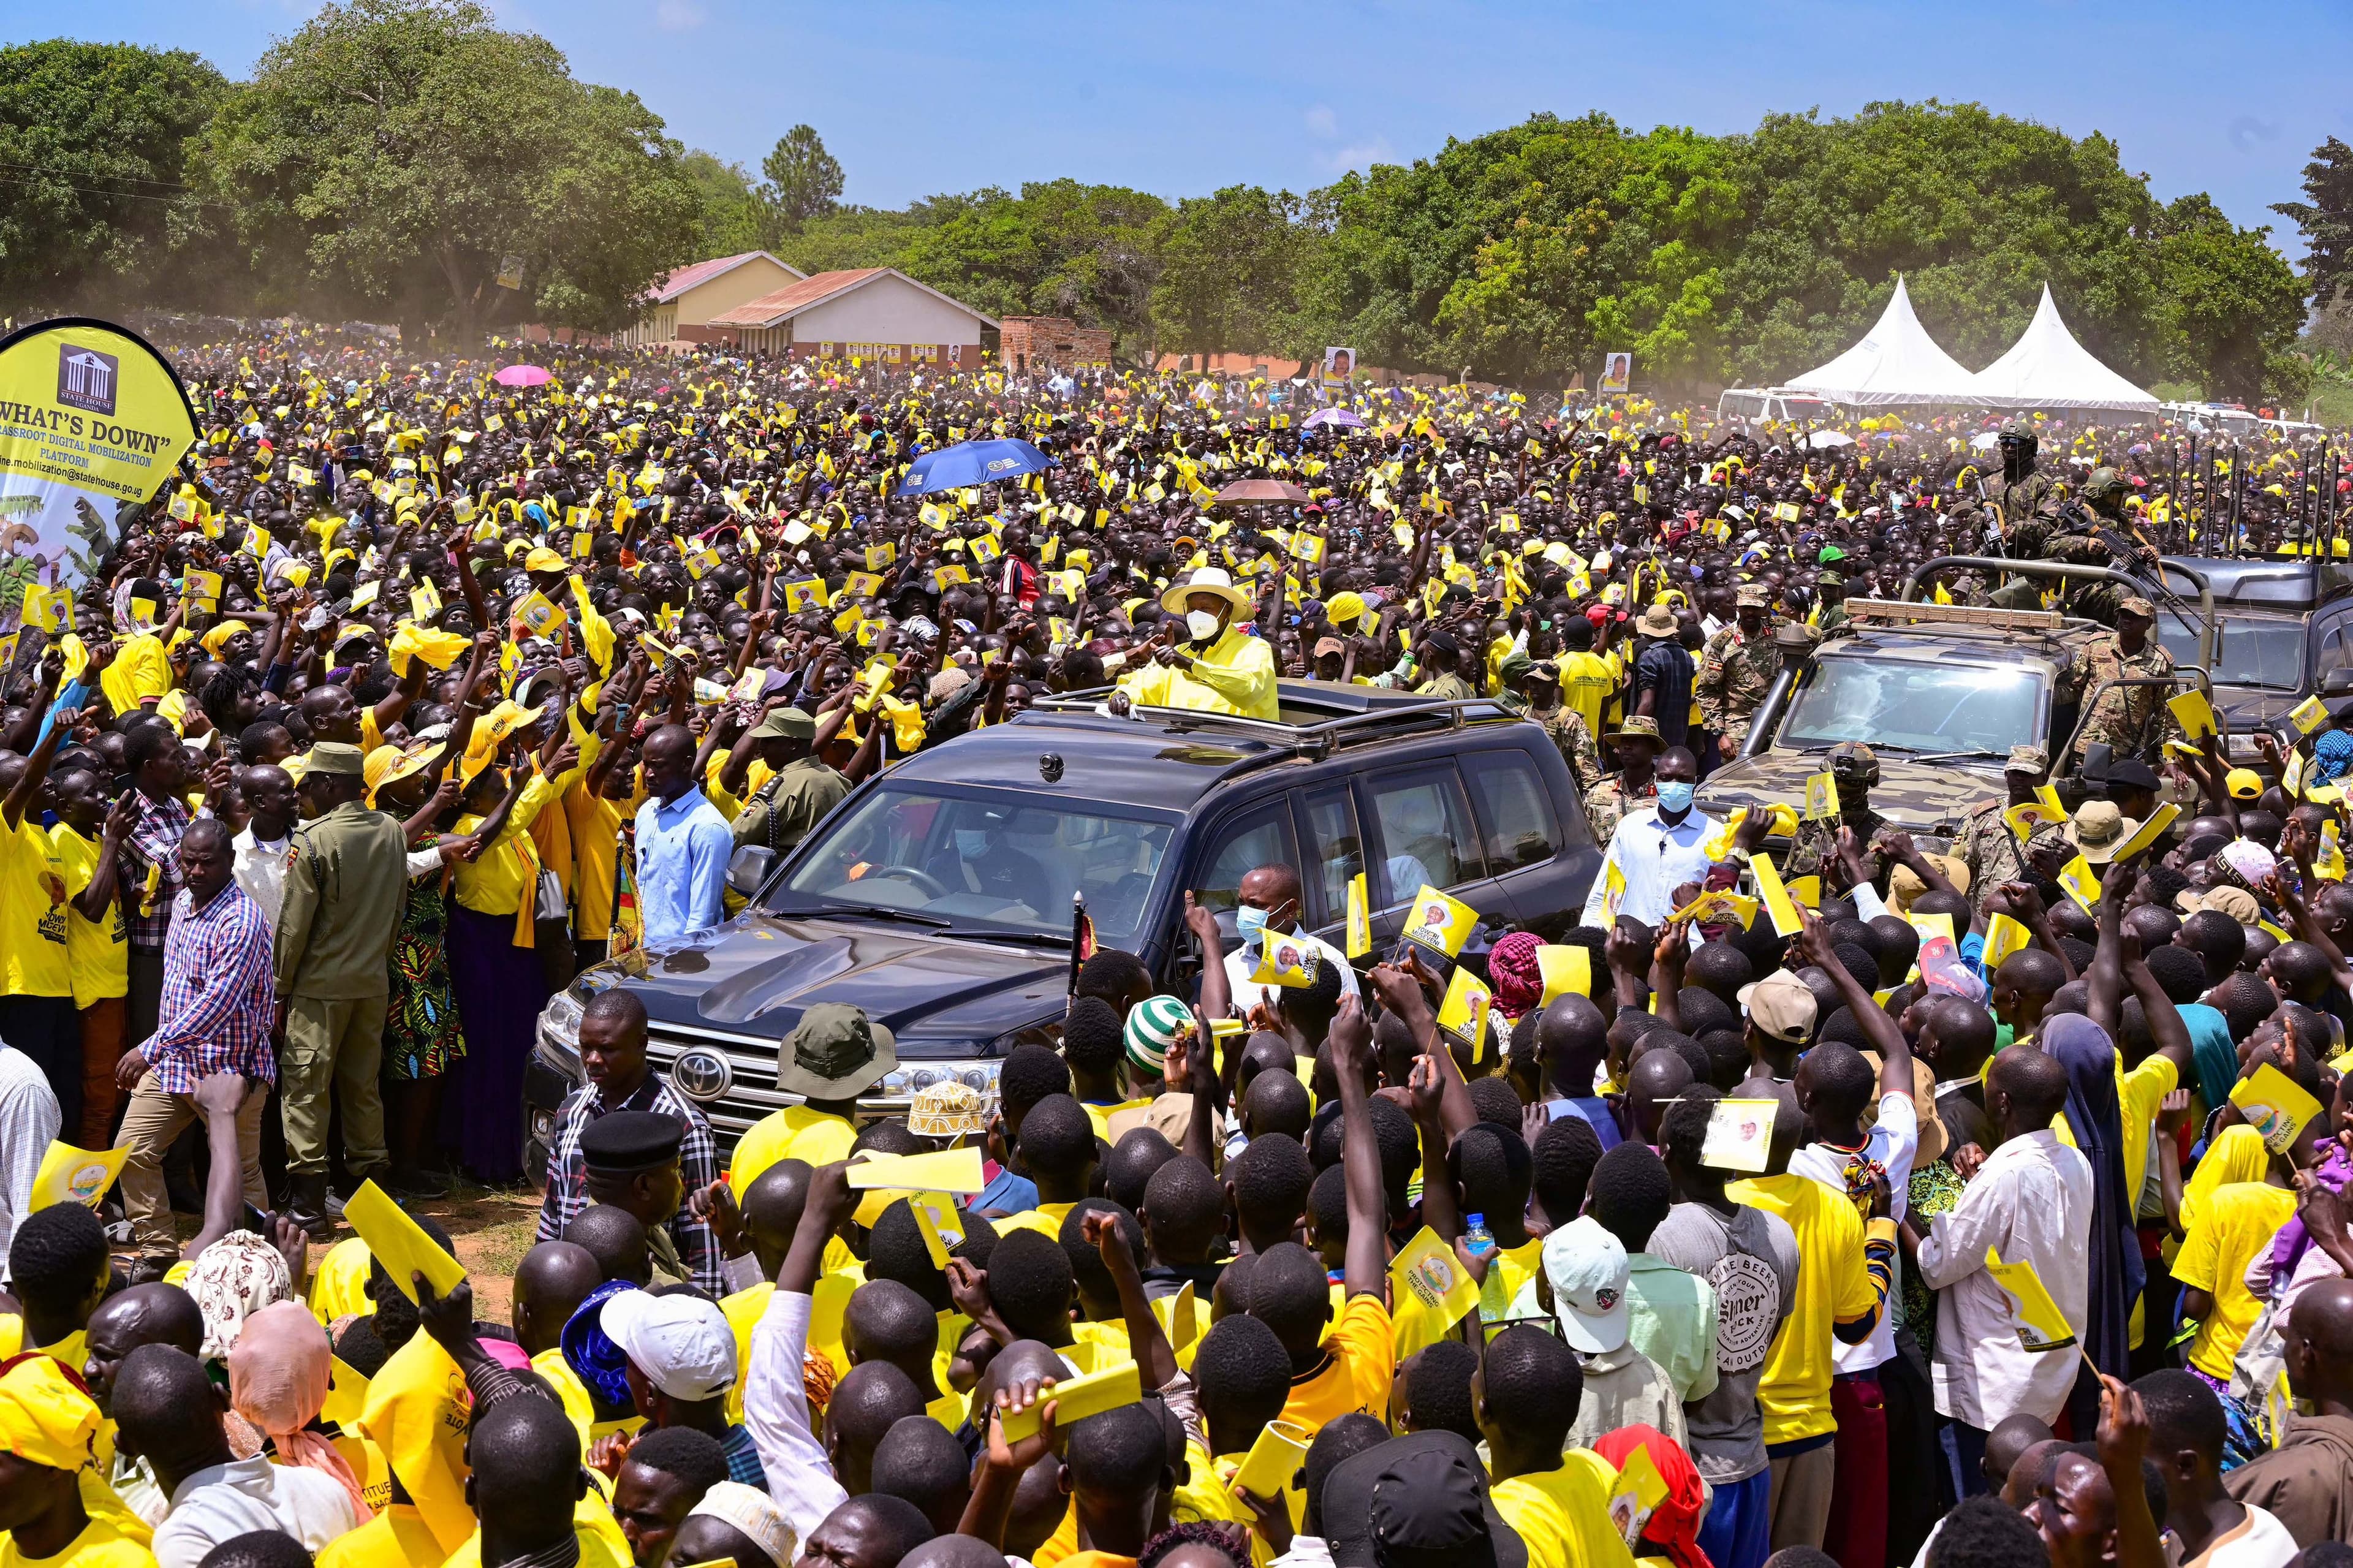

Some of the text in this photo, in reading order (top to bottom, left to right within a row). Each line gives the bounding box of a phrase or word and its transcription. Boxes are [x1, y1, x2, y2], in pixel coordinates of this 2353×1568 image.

[61, 392, 112, 409] STATE HOUSE
[75, 401, 99, 412] UGANDA
[0, 425, 151, 468] ASSROOT DIGITAL MOBILIZATION
[40, 448, 89, 468] PLATFORM
[1324, 640, 1340, 649] CHICAGO
[491, 718, 506, 733] NRM
[1436, 893, 1460, 907] PRESIDENT
[1411, 929, 1440, 947] MUSEVENI
[1417, 925, 1439, 940] YOWERI
[2267, 1115, 2294, 1145] OTECTING
[2279, 1121, 2297, 1143] GAINS
[1709, 1259, 1775, 1288] SHINE BEERS
[1408, 1270, 1440, 1307] PROTECTING
[1408, 1276, 1434, 1309] THE GAINS
[1738, 1279, 1756, 1290] YOUR
[1741, 1314, 1765, 1344] ADVENTURE
